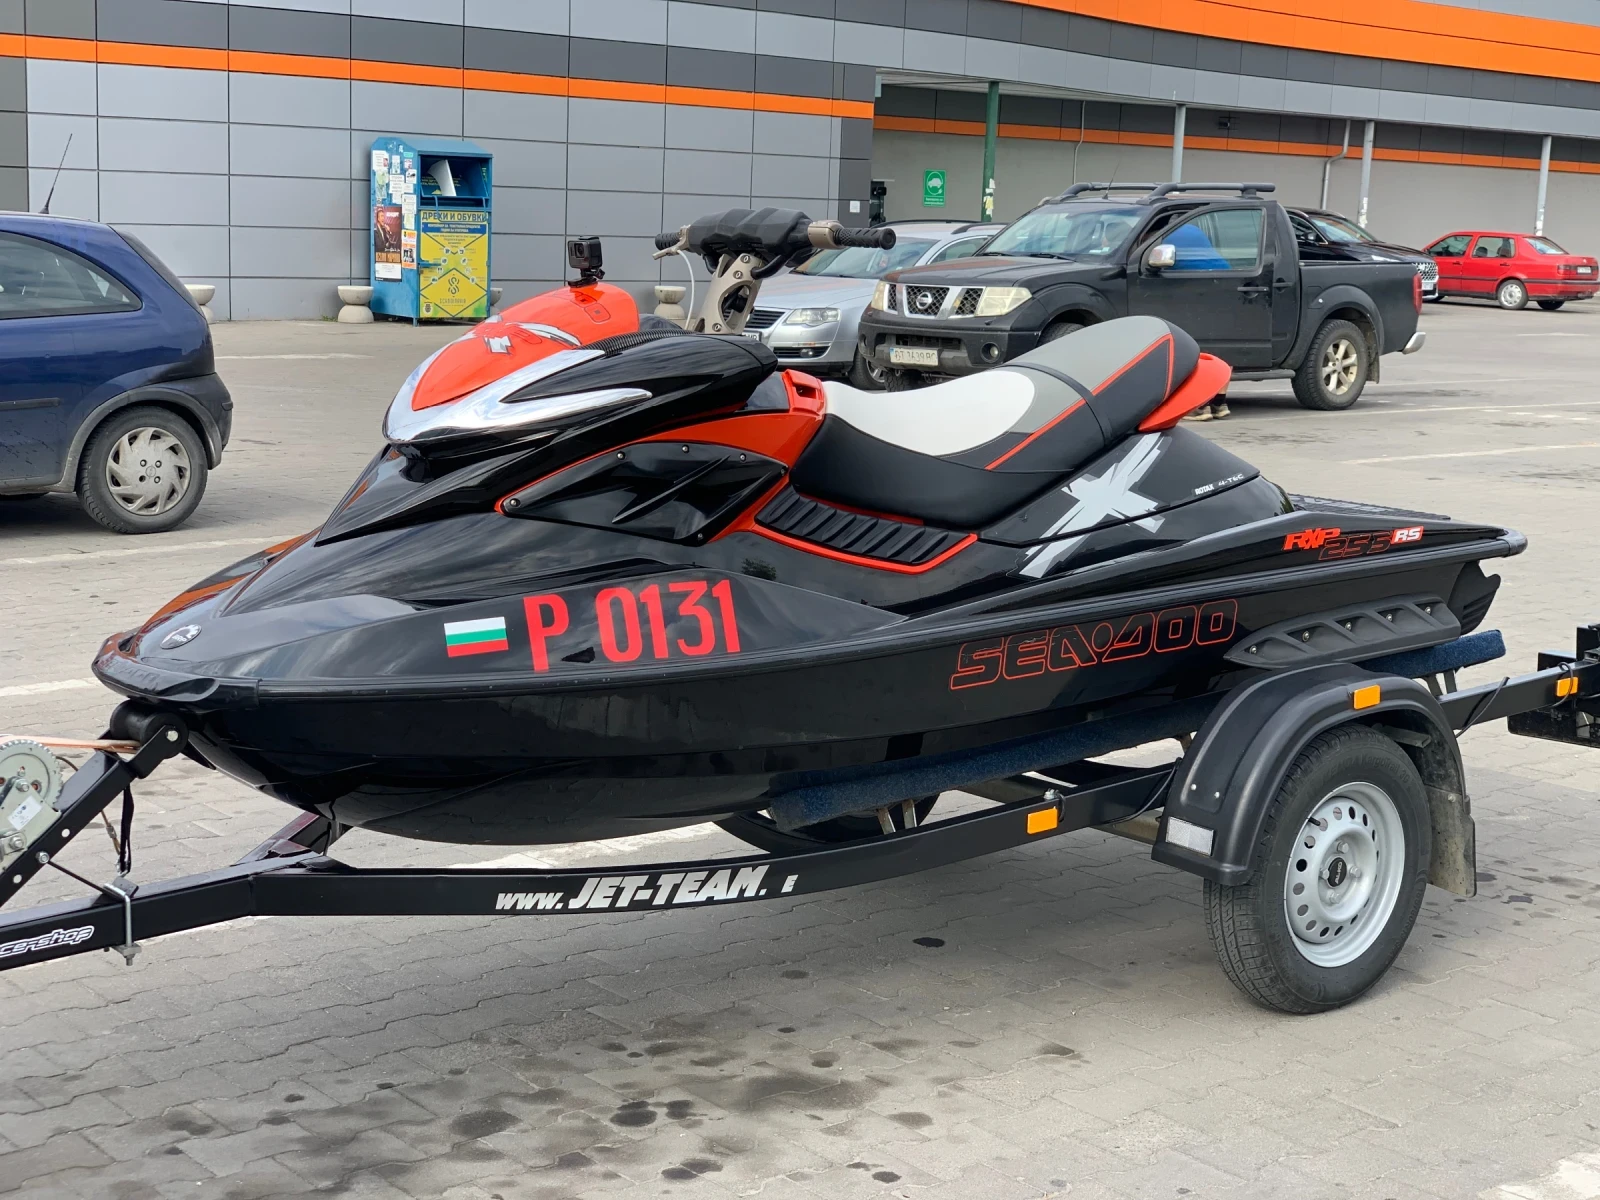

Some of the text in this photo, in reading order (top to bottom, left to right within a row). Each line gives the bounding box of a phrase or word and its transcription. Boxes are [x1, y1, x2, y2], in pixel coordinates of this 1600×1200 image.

[422, 212, 448, 221] ДРЕХИ
[1195, 474, 1244, 495] ROTAX 4-TEC
[1283, 527, 1341, 551] RXP
[1395, 527, 1421, 543] RS
[523, 579, 741, 673] P 0131
